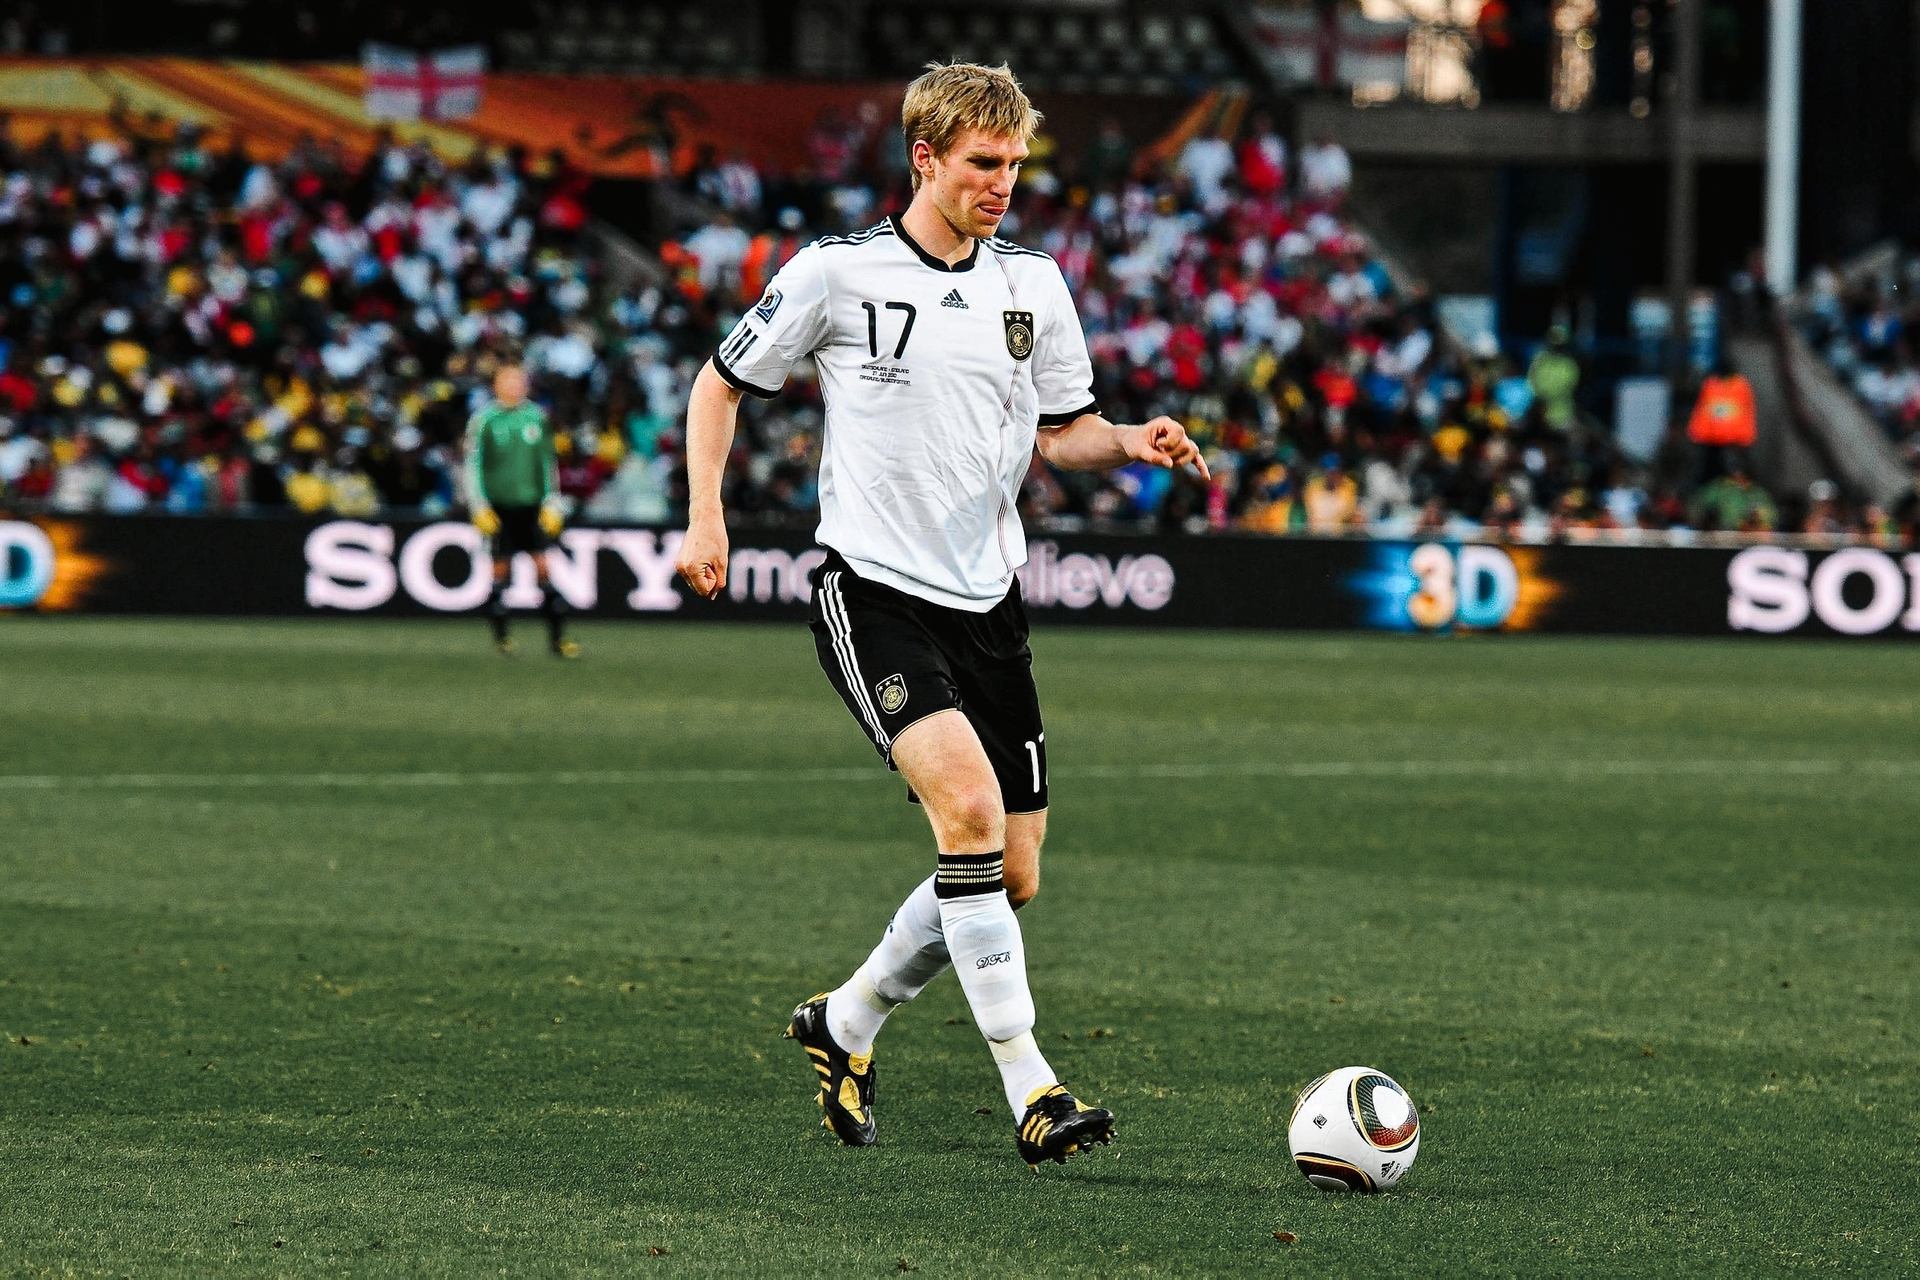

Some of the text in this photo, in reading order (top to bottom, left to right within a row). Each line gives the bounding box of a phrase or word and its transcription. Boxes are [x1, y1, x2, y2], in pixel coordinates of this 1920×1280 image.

[861, 301, 917, 360] 17
[940, 300, 969, 310] adidas
[304, 519, 686, 611] SONY
[1407, 543, 1518, 627] 3D
[1727, 545, 1920, 635] SO
[1025, 731, 1047, 793] 1
